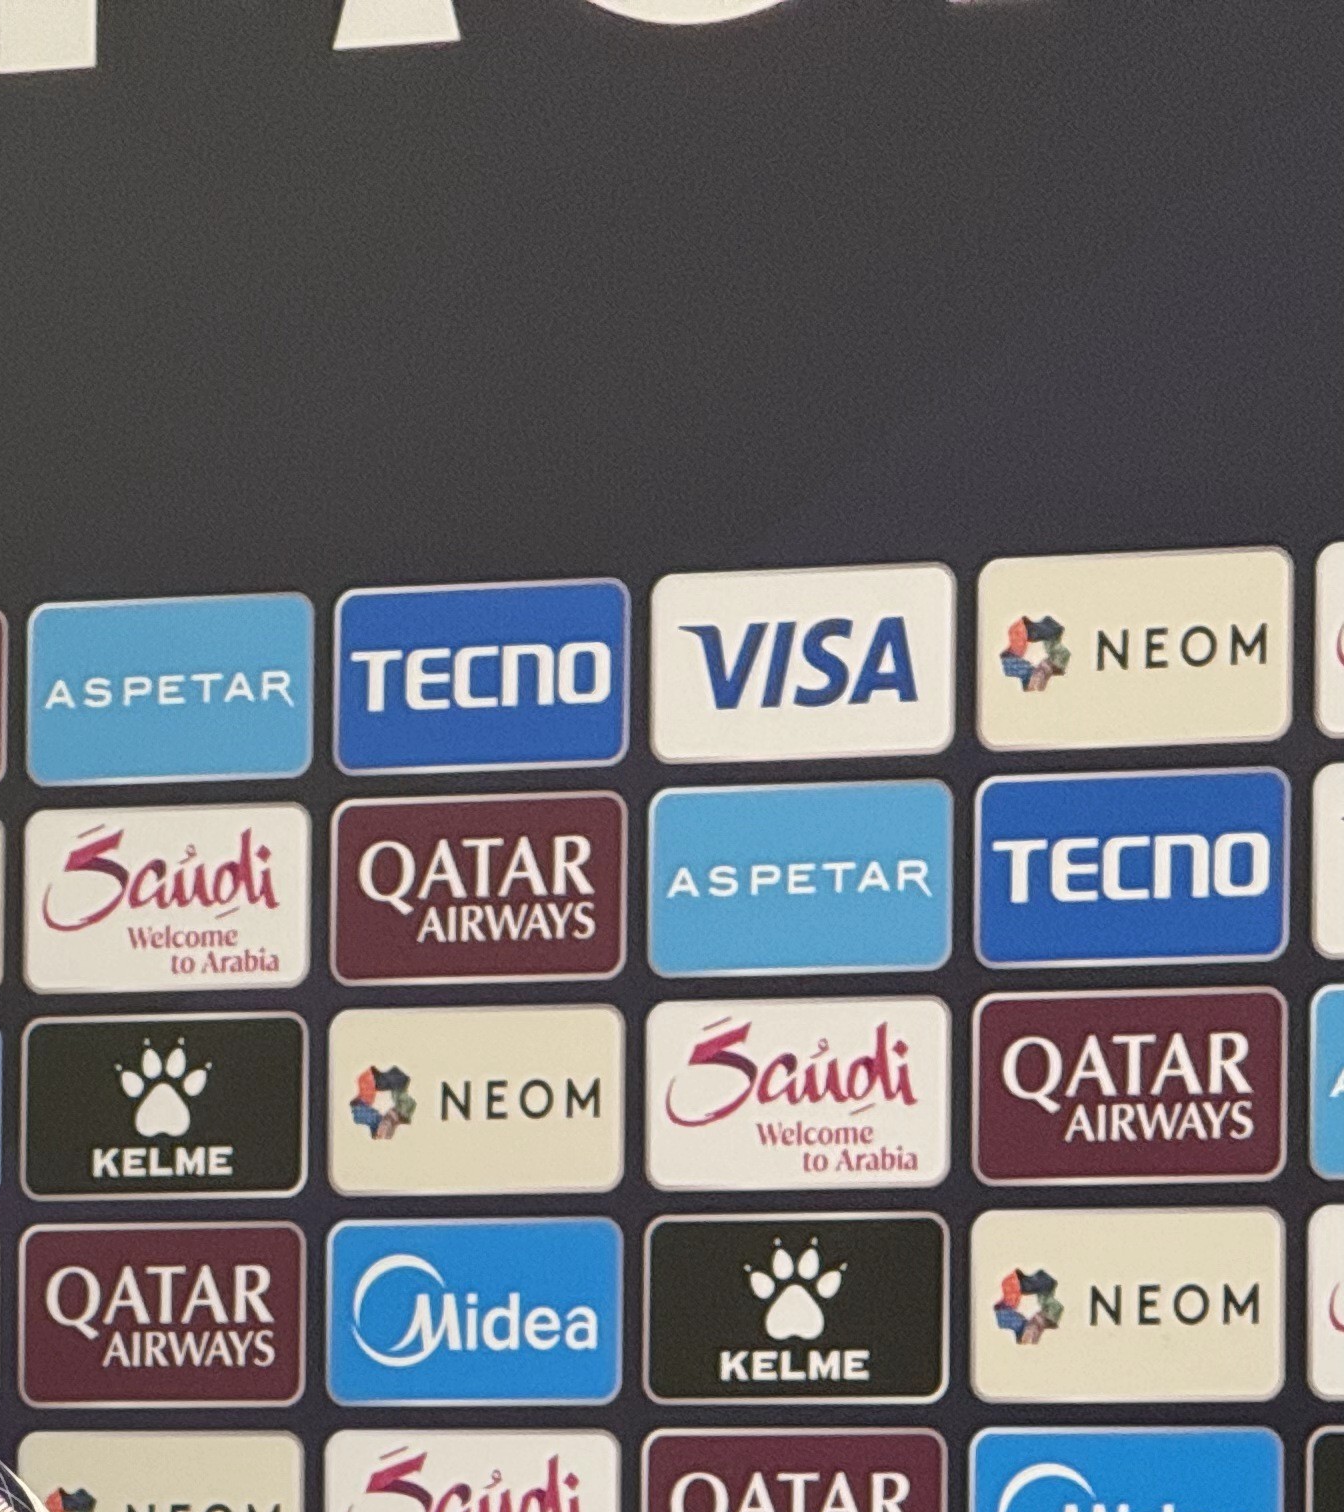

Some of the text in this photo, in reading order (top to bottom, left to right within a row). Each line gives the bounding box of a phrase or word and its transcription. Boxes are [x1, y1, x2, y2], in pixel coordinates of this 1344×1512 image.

[678, 616, 918, 710] VISA
[1097, 623, 1267, 671] NEOM
[45, 670, 294, 710] ASPETAR
[351, 641, 610, 712] TECNO
[42, 824, 280, 931] Saudi
[359, 835, 594, 915] QATAR
[667, 859, 933, 898] ASPETAR
[991, 832, 1269, 904] TECNO
[127, 926, 238, 951] Welcome
[417, 902, 595, 943] AIRWAYS
[171, 948, 280, 974] to Arabia
[666, 1016, 918, 1128] Saudi
[1002, 1031, 1253, 1114] QATAR
[440, 1078, 601, 1121] NEOM
[756, 1122, 874, 1147] Welcome
[1063, 1101, 1254, 1143] AIRWAYS
[92, 1145, 233, 1179] KELME
[802, 1147, 919, 1173] to Arabia
[46, 1264, 275, 1340] QATAR
[364, 1283, 598, 1356] Midea
[1090, 1283, 1260, 1326] NEOM
[103, 1331, 276, 1368] AIRWAYS
[719, 1350, 871, 1381] KELME
